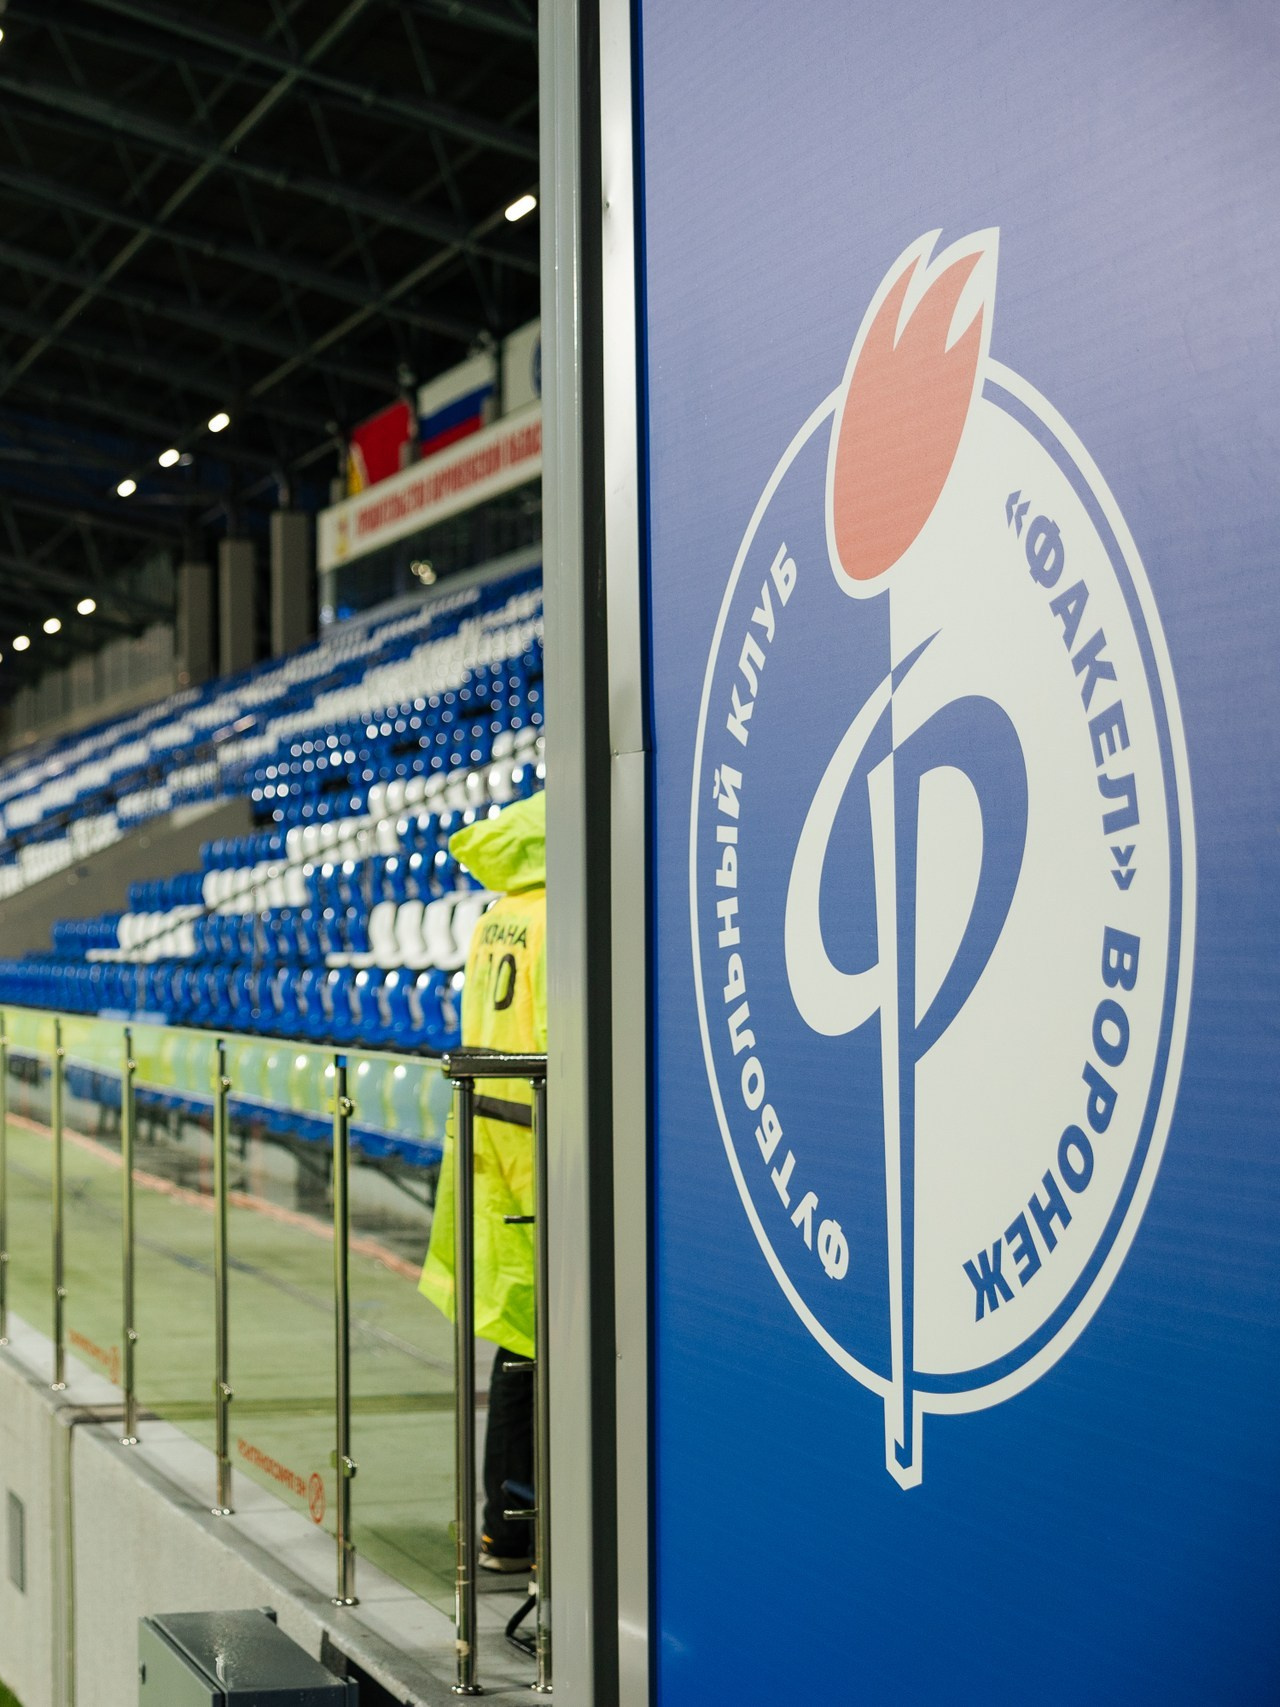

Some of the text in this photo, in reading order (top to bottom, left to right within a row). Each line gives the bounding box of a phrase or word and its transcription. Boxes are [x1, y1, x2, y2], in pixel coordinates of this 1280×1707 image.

[713, 489, 1141, 1322] ФУТБОЛЬНЫЙ КЛУБ «ФАКЕЛ» ВОРОНЕЖ
